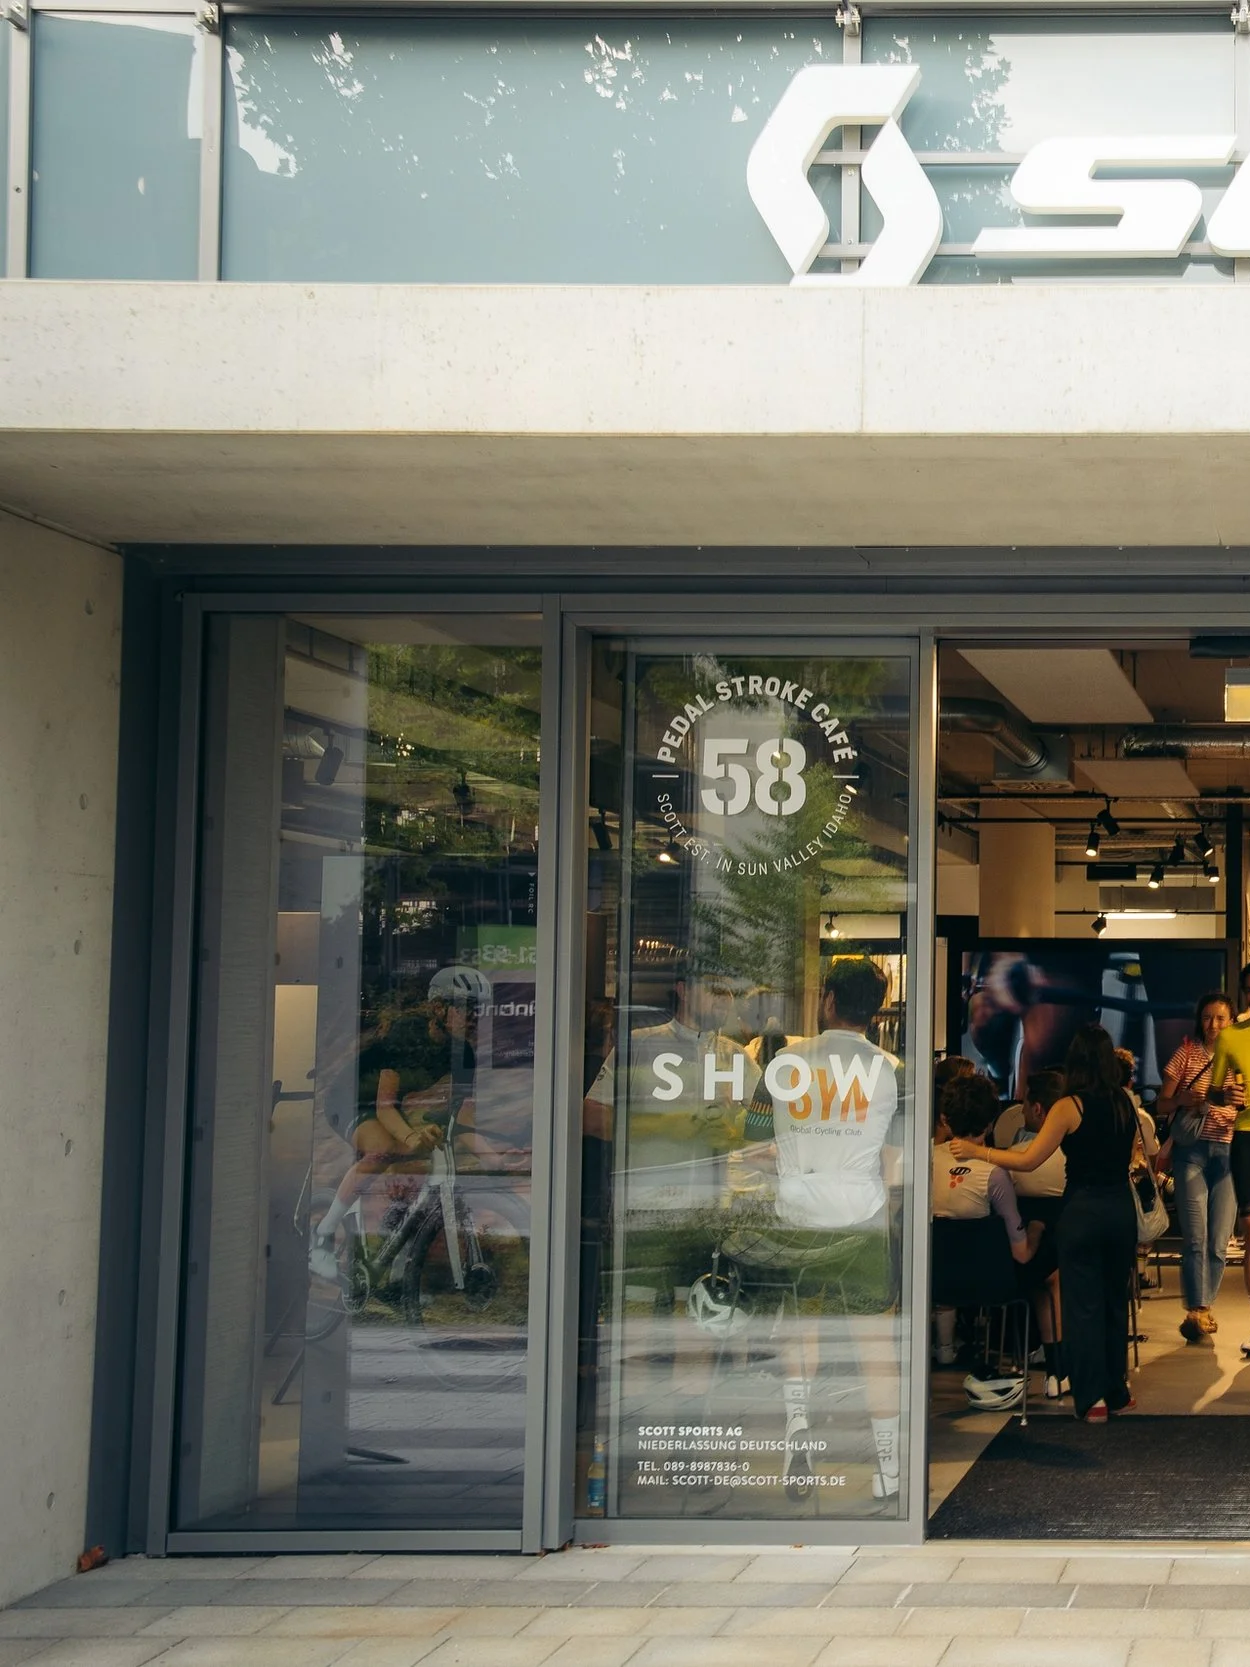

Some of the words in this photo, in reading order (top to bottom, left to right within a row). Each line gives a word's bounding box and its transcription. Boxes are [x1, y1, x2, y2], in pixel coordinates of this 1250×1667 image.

[657, 694, 715, 763] PEDAL
[716, 675, 814, 710] STROKE
[811, 703, 858, 763] CAFÉ
[701, 738, 806, 816] 58
[657, 793, 687, 838] SCOTT
[684, 838, 710, 865] EST.
[716, 857, 733, 873] IN
[737, 862, 768, 876] SUN
[773, 838, 824, 873] VALLEY
[822, 793, 852, 839] IDAHO
[652, 1053, 884, 1101] SHOW
[790, 1124, 812, 1134] Global
[815, 1127, 842, 1136] Cycling
[845, 1128, 862, 1136] Club
[638, 1426, 676, 1437] SCOTT
[678, 1426, 723, 1437] SPORTS
[726, 1427, 743, 1437] AG
[638, 1440, 737, 1451] NIEDERLASSUNG
[739, 1440, 827, 1451] DEUTSCHLAND
[637, 1461, 661, 1472] TEL.
[663, 1461, 750, 1472] 089-8987836-0
[637, 1475, 670, 1486] MAIL:
[672, 1475, 846, 1487] SCOTT-DE@SCOTT-SPORTS.DE
